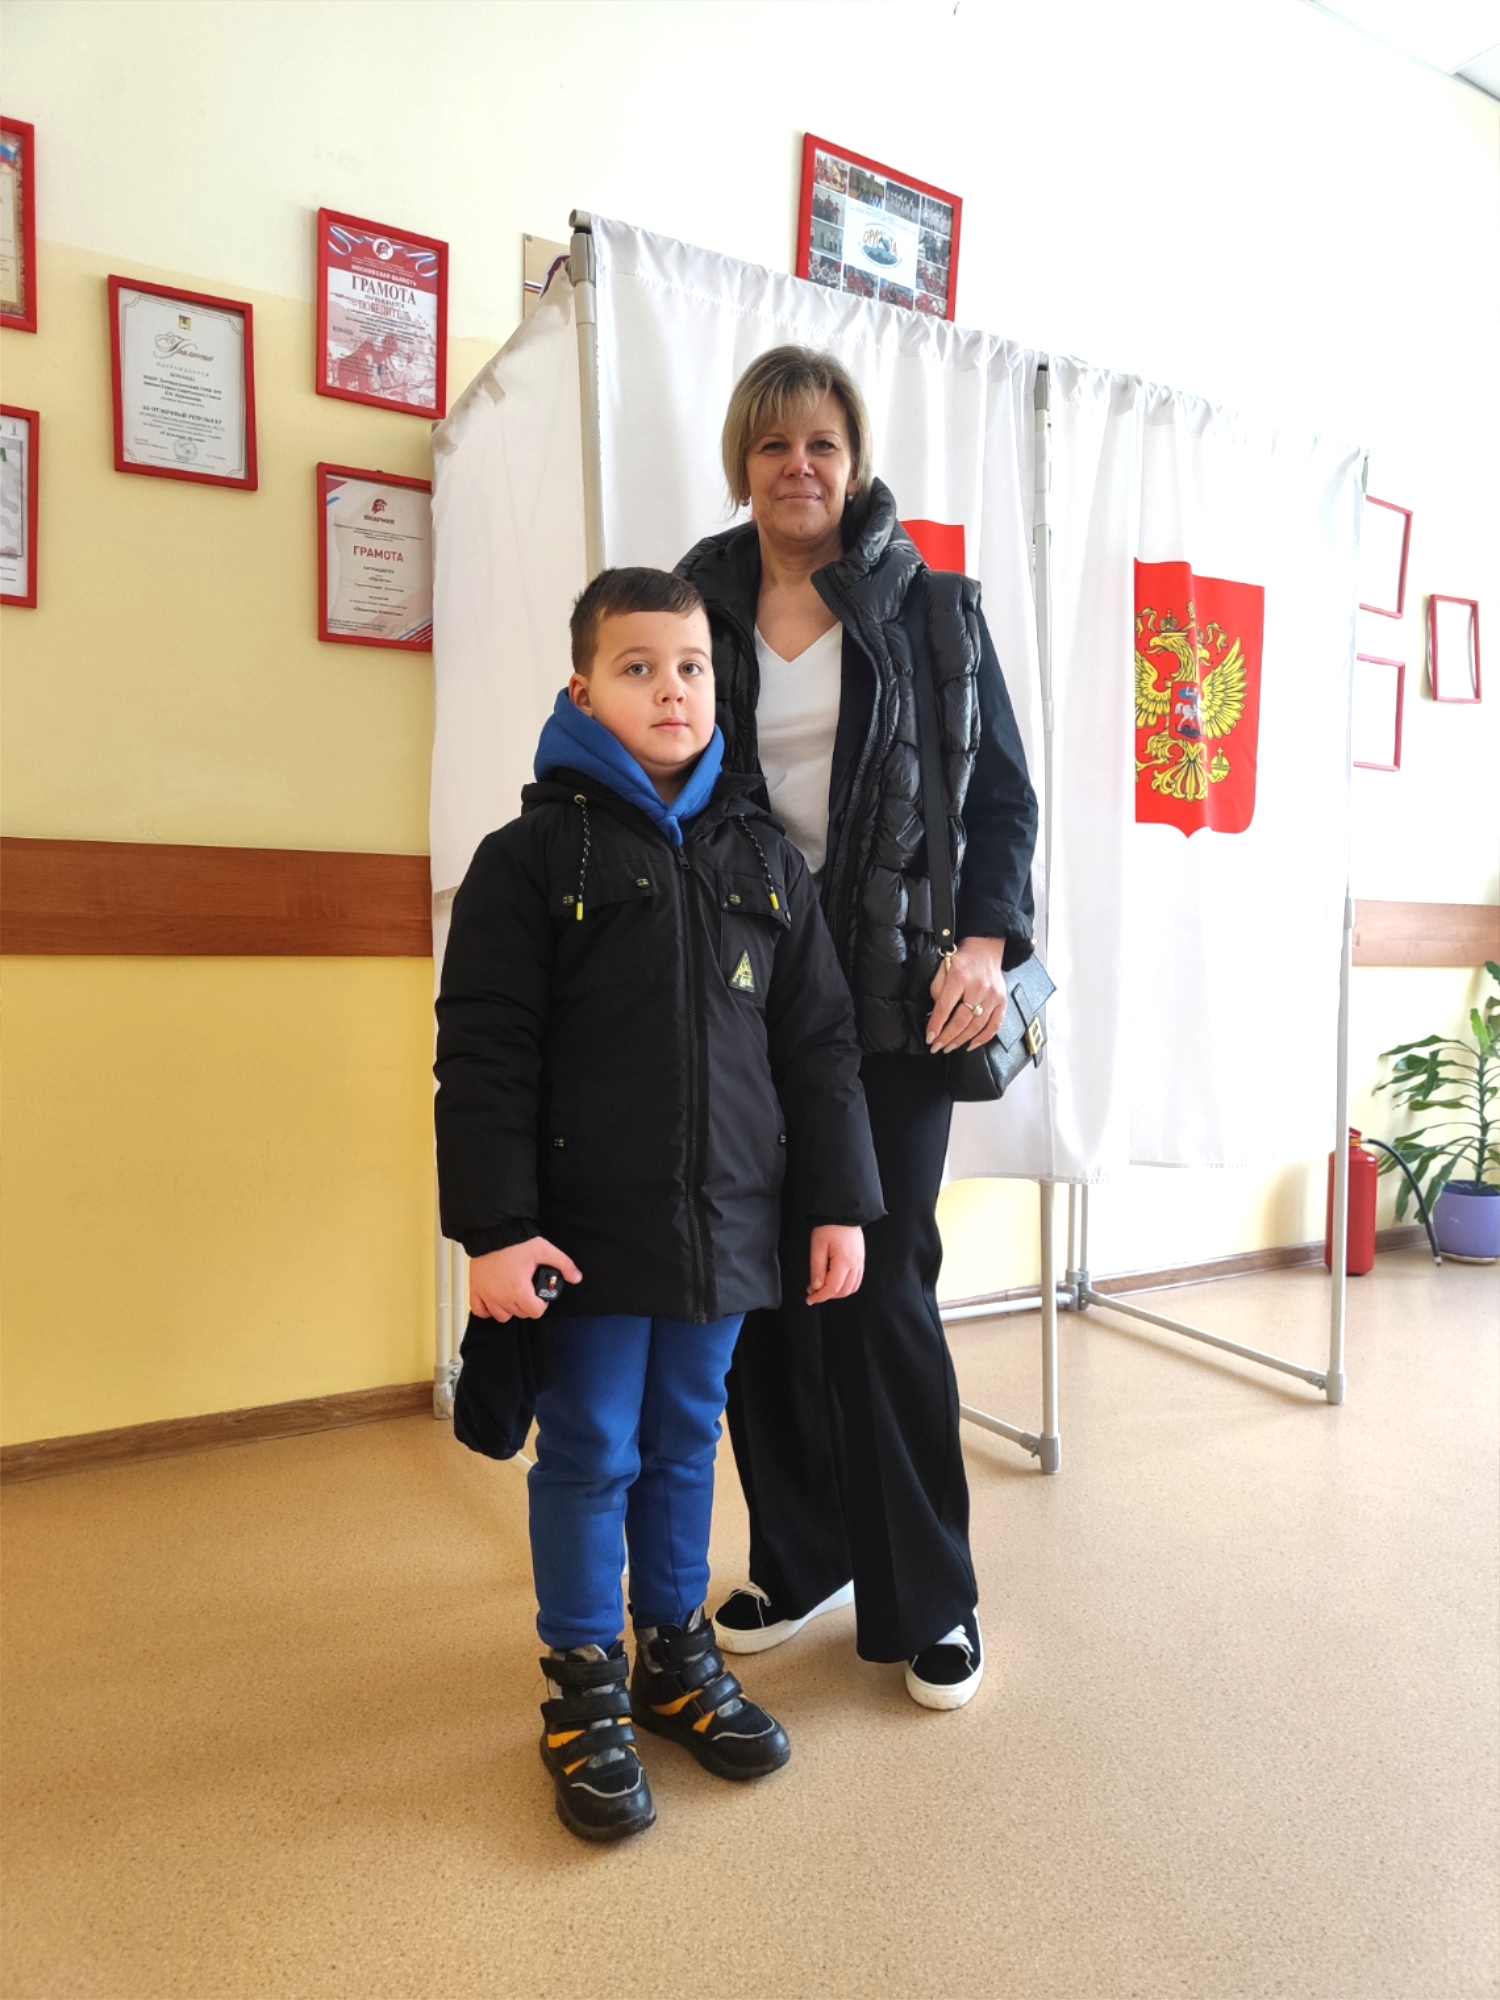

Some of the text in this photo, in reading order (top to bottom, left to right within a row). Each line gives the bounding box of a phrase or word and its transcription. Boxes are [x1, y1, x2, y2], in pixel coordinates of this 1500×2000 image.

[351, 264, 390, 279] МОСКОВСКАЯ
[352, 274, 416, 305] ГРАМОТА
[358, 300, 412, 321] ПОБЕДИТЕЛЬ
[353, 545, 405, 563] ГРАМОТА
